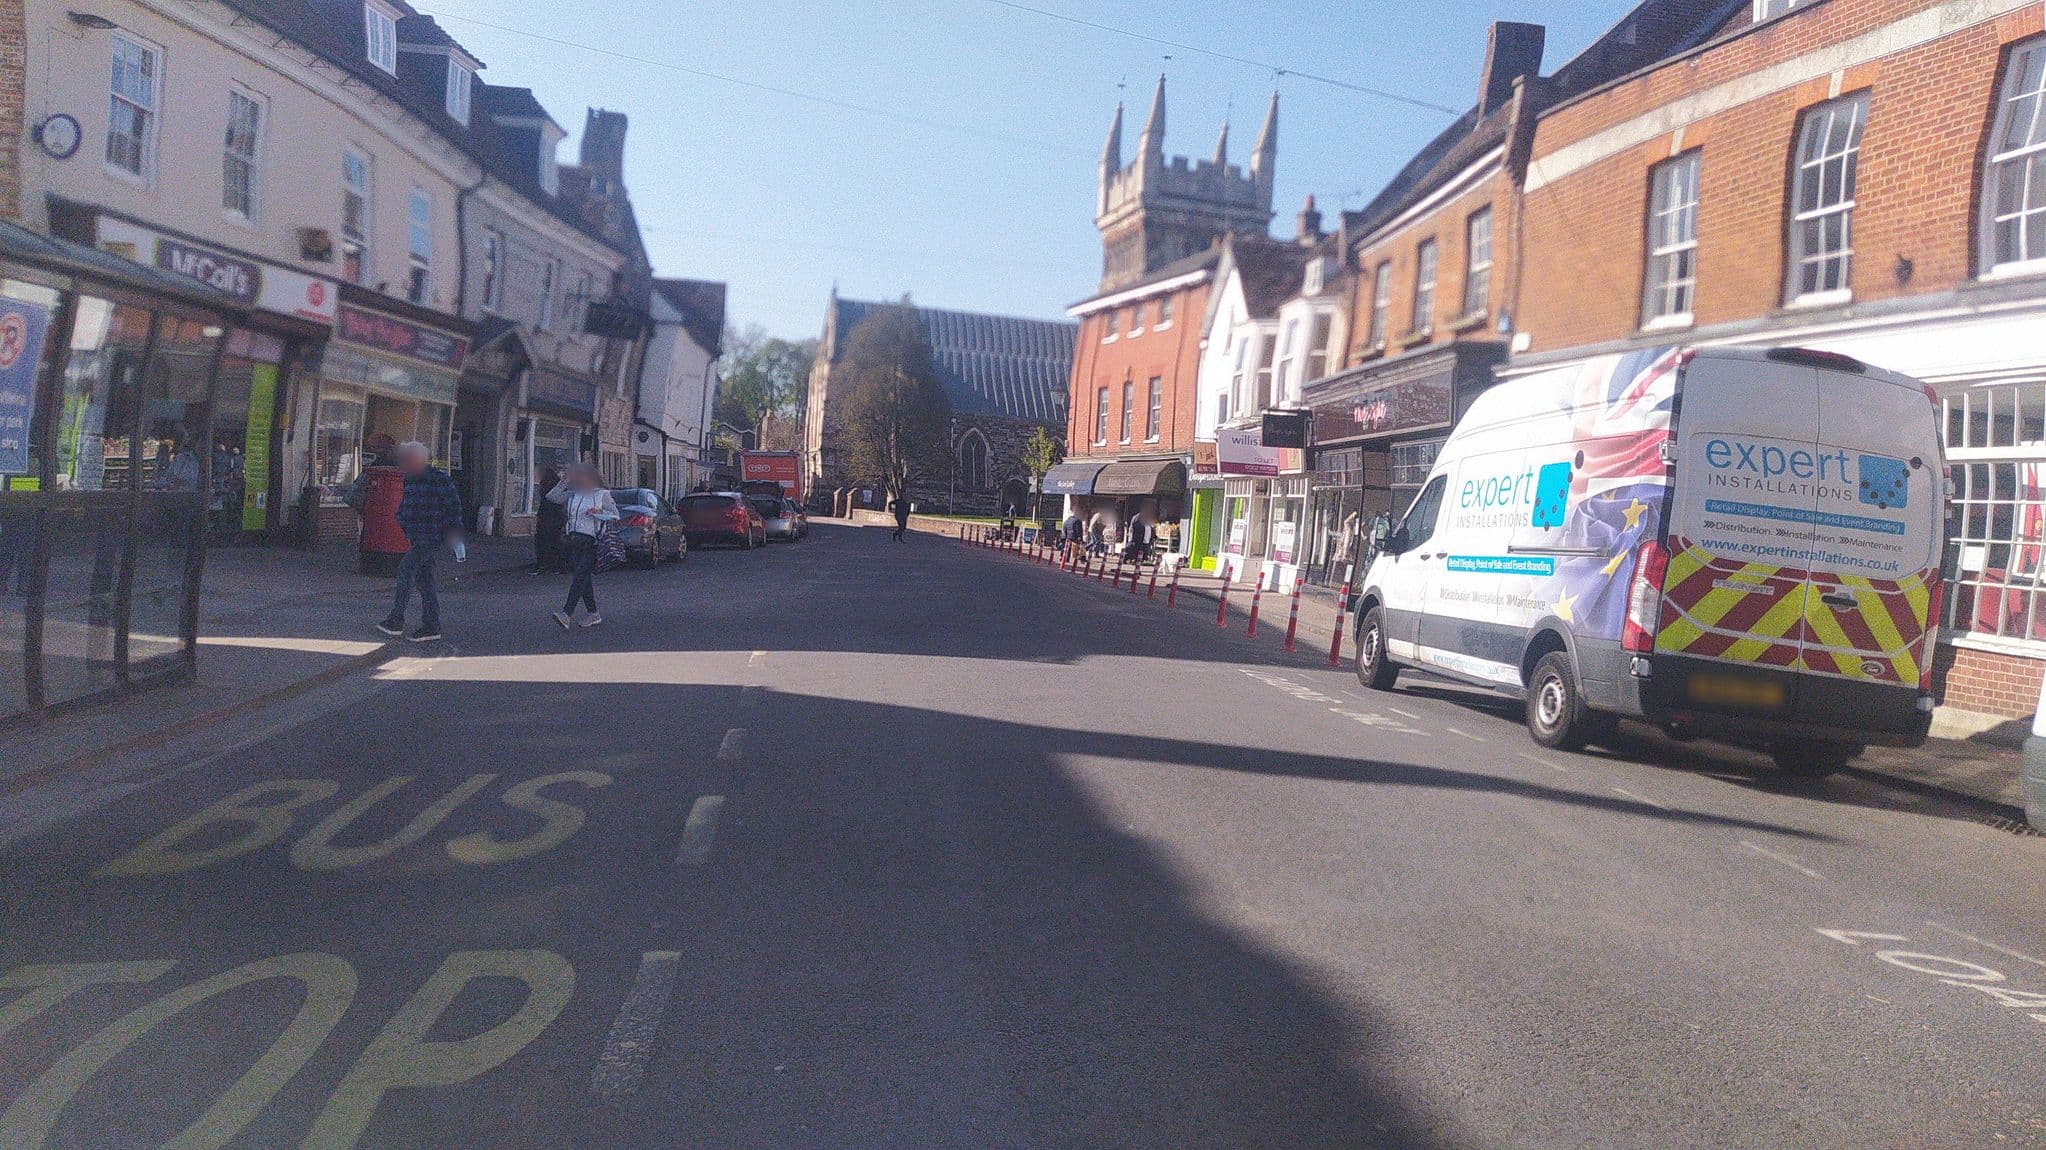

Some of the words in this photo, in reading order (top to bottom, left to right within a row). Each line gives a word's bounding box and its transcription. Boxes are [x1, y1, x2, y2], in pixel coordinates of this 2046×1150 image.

[1231, 435, 1258, 446] willis
[1705, 438, 1853, 485] expert
[1461, 465, 1534, 511] expert
[1707, 473, 1853, 501] INSTALLATIONS
[1456, 512, 1529, 529] INSTALLATIONS
[1715, 521, 1771, 536] Distribution
[1787, 530, 1836, 543] Installation
[1849, 538, 1904, 552] Maintenance
[1701, 539, 1900, 572] www.expertinstallations.co.uk
[90, 769, 614, 878] BUS
